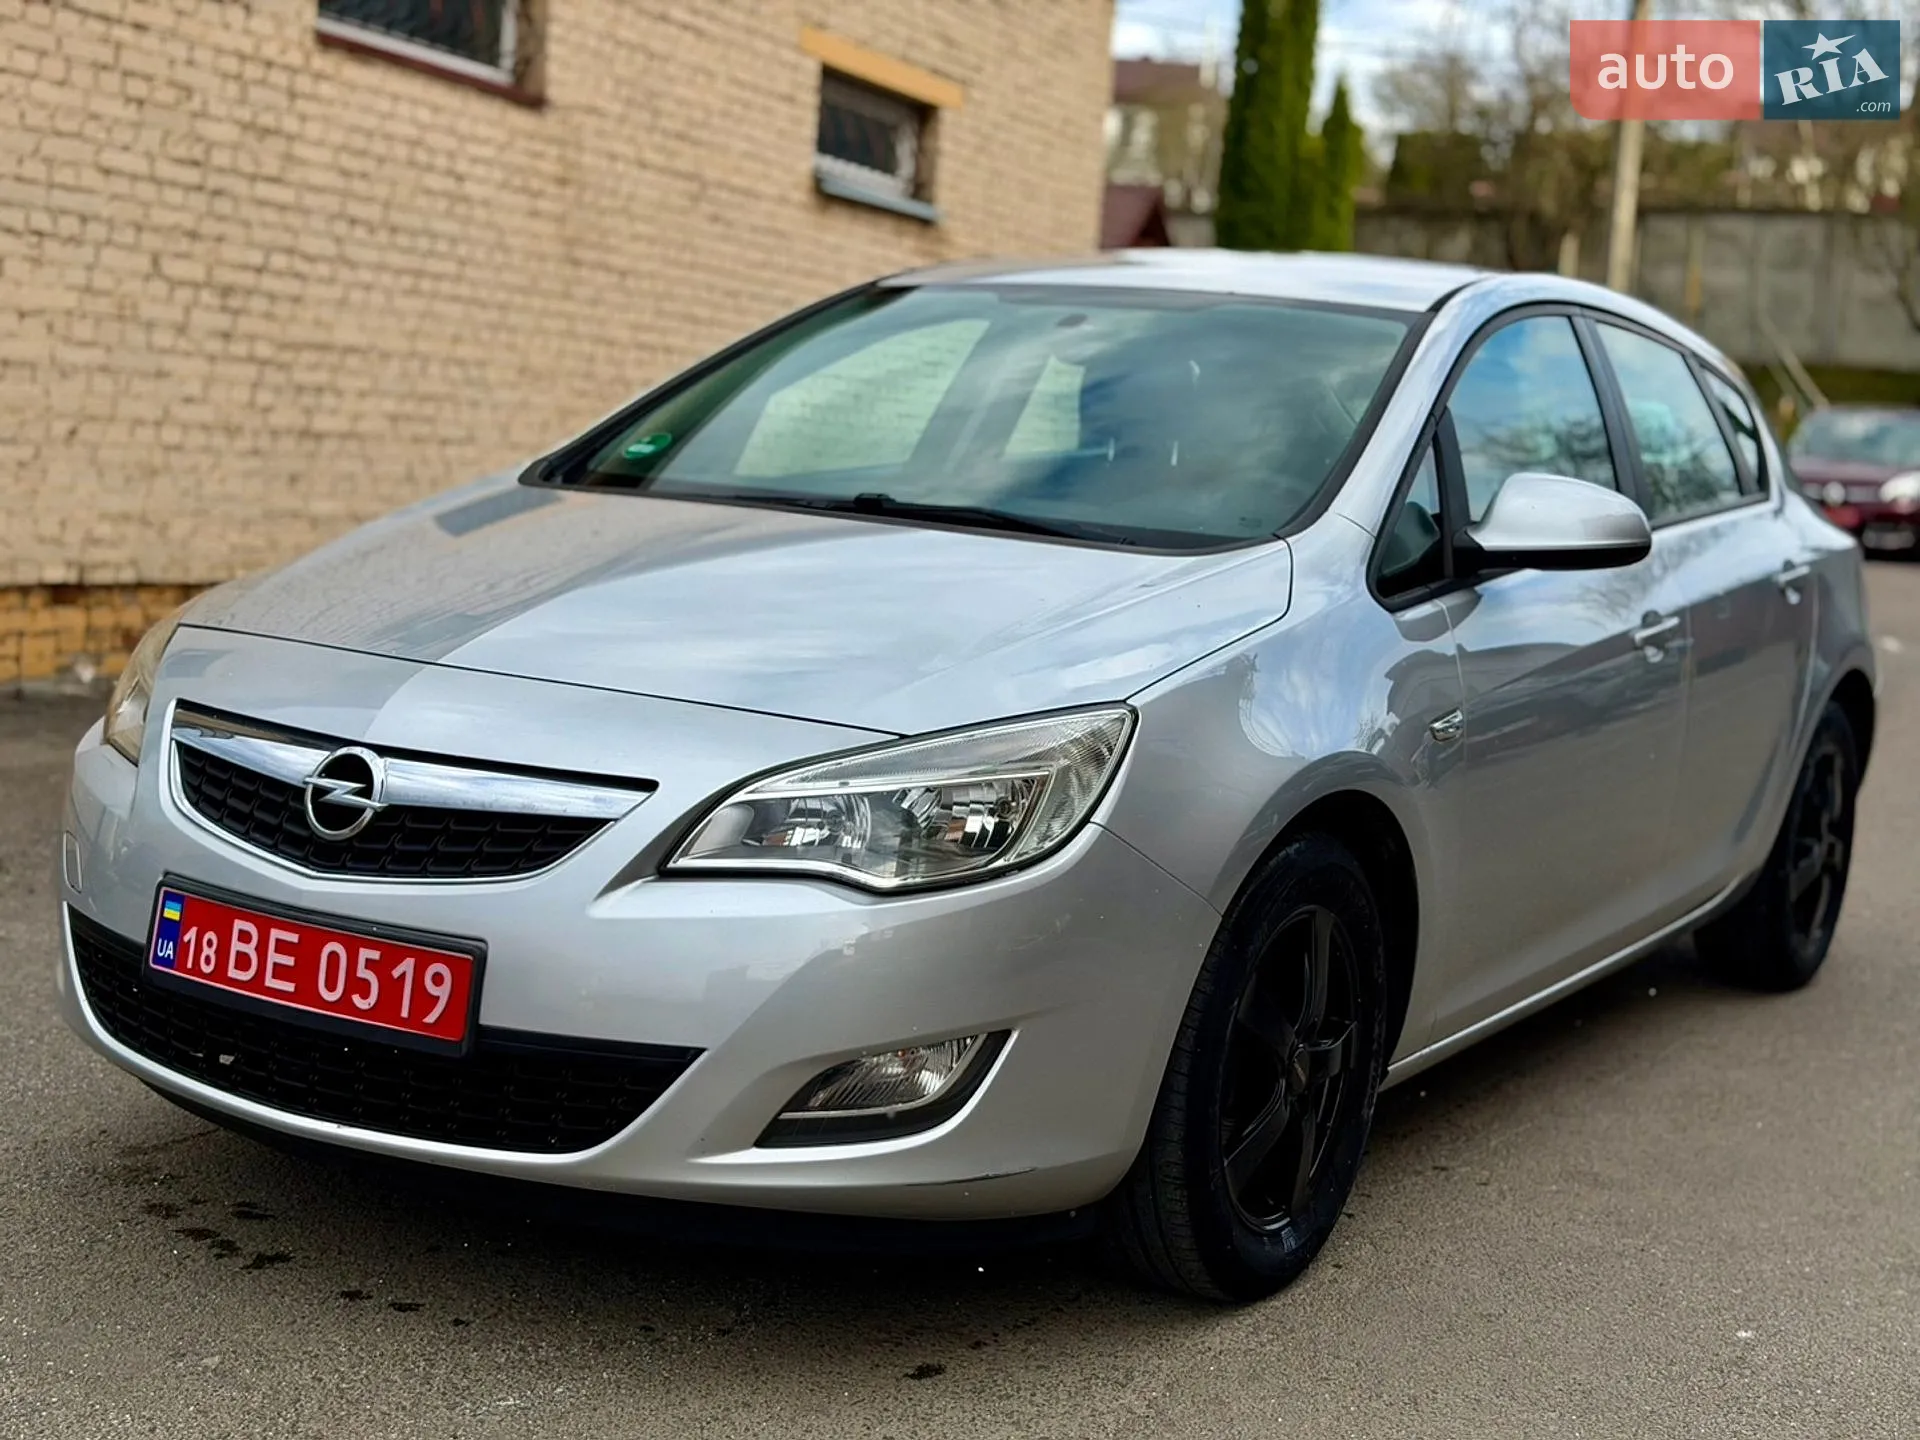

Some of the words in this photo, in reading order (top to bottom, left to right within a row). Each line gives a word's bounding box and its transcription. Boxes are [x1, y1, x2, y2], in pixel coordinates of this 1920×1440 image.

[157, 937, 175, 961] UA
[183, 925, 219, 974] 18
[227, 918, 300, 993] BE
[317, 941, 452, 1024] 0519
